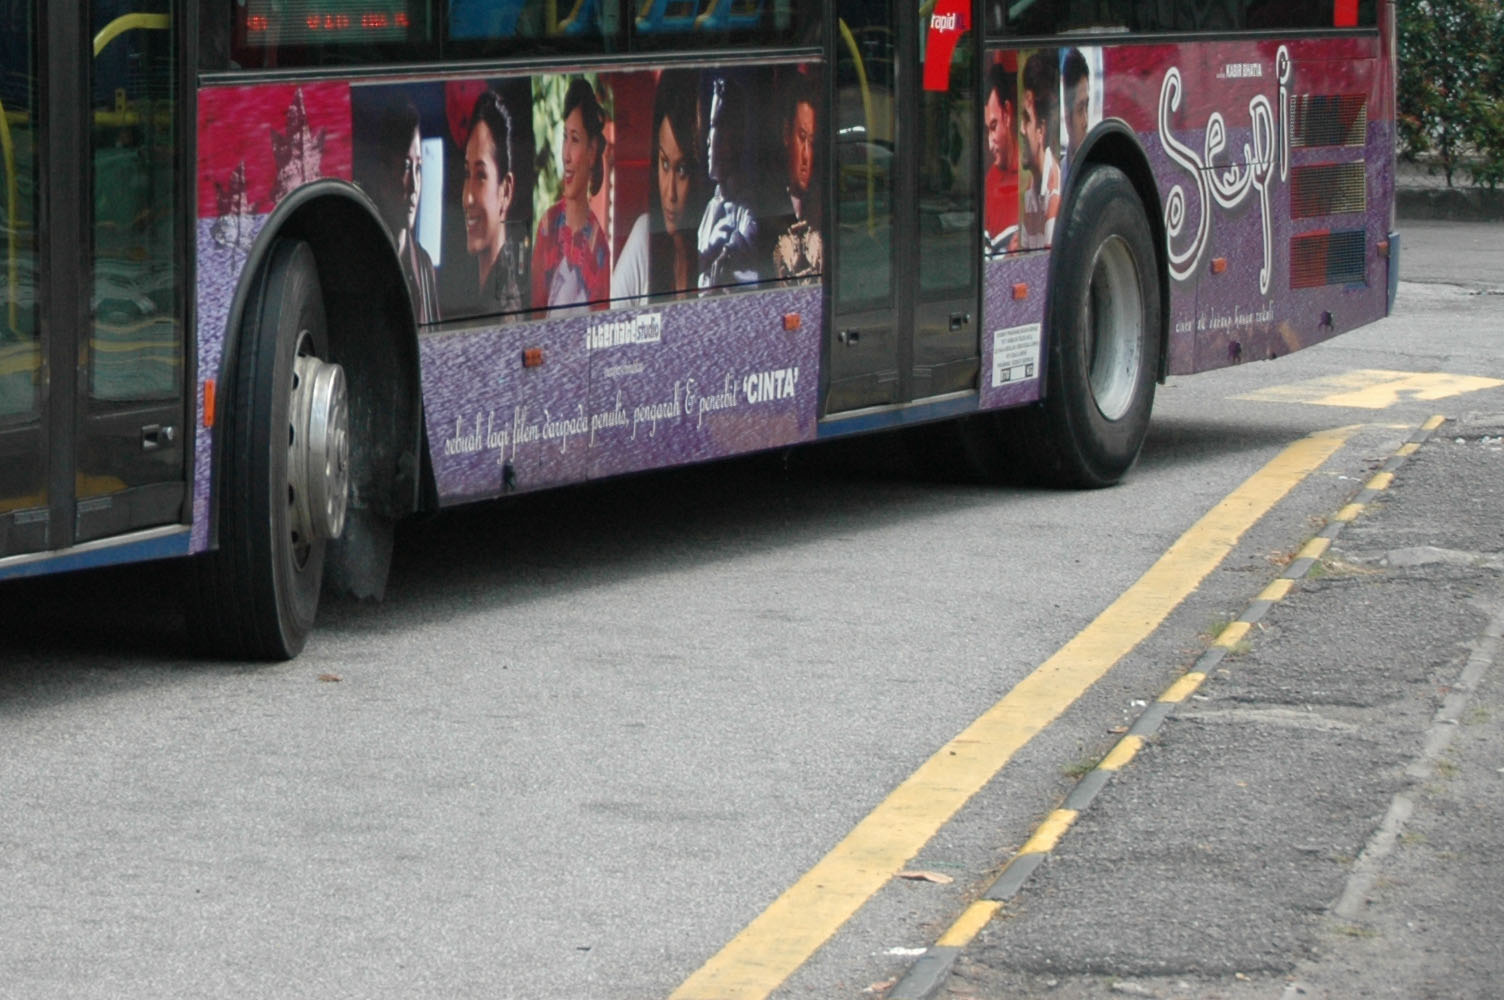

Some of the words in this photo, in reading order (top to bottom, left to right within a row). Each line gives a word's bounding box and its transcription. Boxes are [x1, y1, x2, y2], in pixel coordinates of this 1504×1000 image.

[637, 316, 659, 340] studio
[445, 414, 482, 455] sebuah
[487, 410, 509, 464] lagi
[510, 405, 540, 463] filem
[542, 404, 588, 455] daripada
[631, 380, 681, 440] pengarah
[696, 372, 738, 429] penerbit
